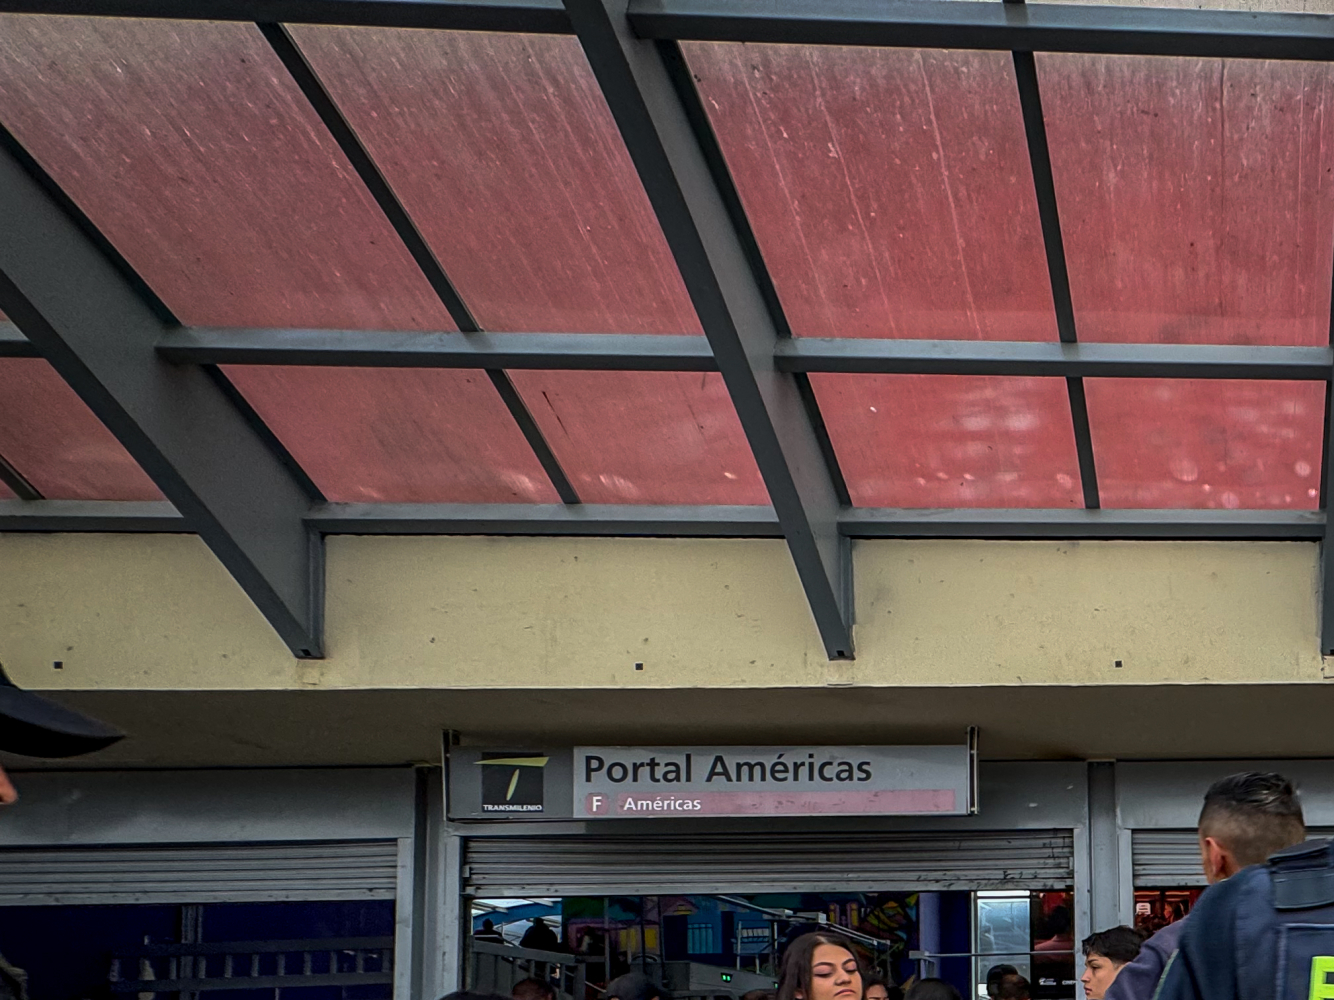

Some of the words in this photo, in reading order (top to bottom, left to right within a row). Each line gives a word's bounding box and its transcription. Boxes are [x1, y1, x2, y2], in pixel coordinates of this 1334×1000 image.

[584, 753, 692, 783] Portal
[705, 753, 873, 782] Américas
[592, 796, 602, 811] F
[623, 796, 701, 811] Américas
